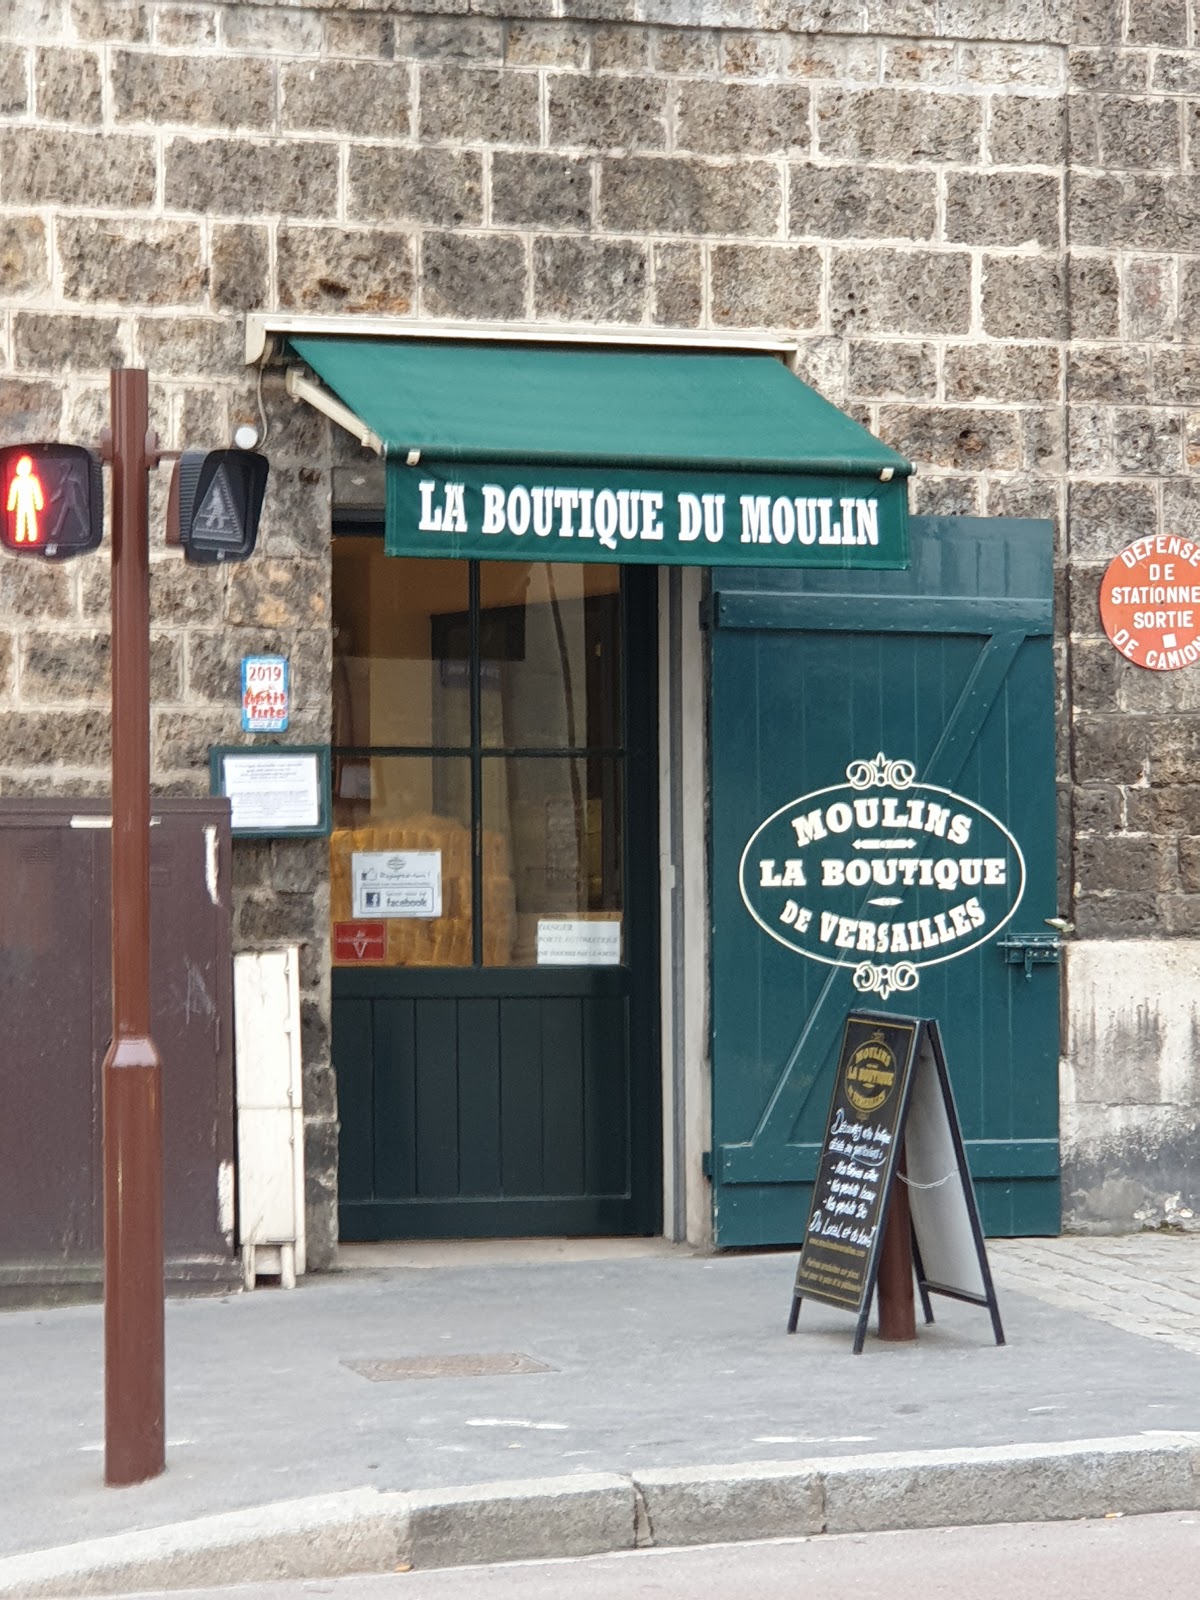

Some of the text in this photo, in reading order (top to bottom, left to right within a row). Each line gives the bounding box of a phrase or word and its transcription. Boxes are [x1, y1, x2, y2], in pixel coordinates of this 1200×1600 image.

[418, 480, 879, 550] LA BOUTIQUE DU MOULIN
[1121, 536, 1200, 569] DEFENSE
[1149, 563, 1175, 581] DE
[1111, 586, 1200, 605] STATIONNE
[1133, 610, 1194, 629] SORTIE
[1112, 629, 1139, 657] DE
[249, 666, 282, 681] 2019
[791, 798, 973, 847] MOULINS
[759, 858, 1006, 890] LA BOUTIQUE
[386, 897, 427, 908] facebook
[779, 897, 986, 953] DE VERSAILLES
